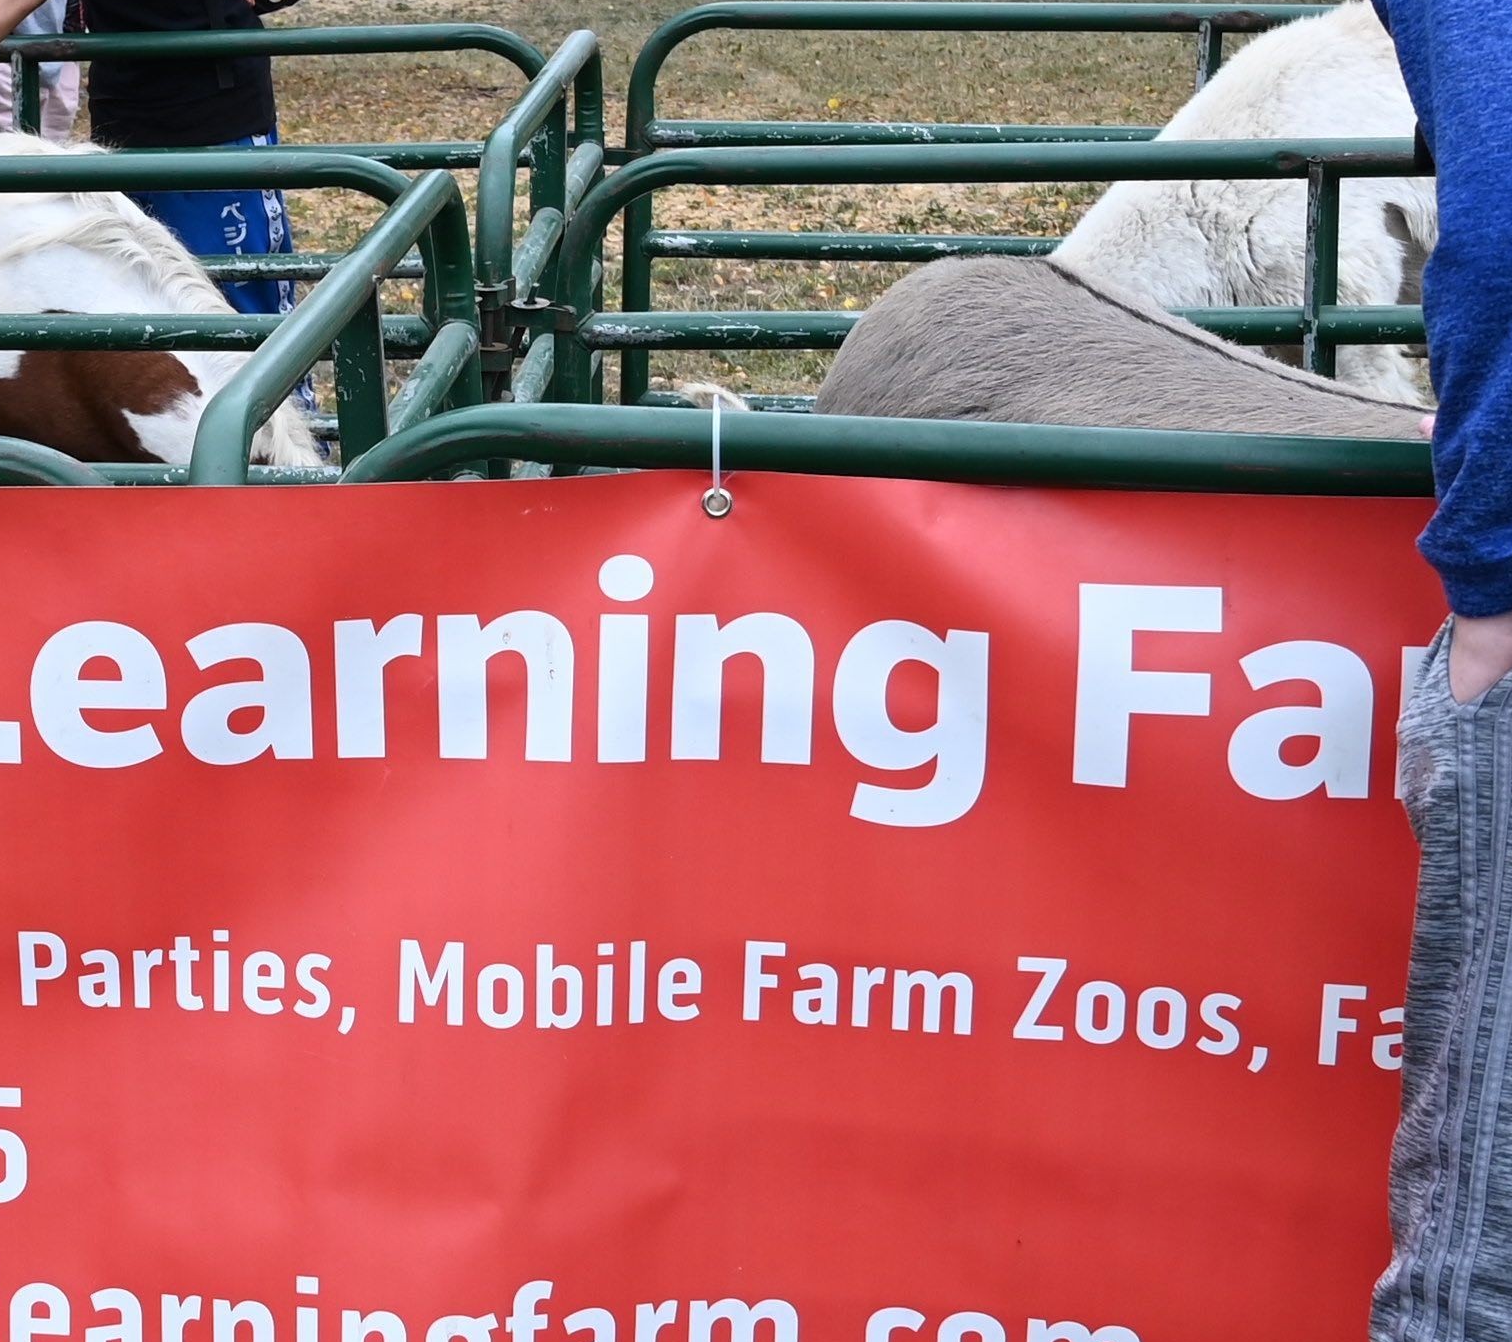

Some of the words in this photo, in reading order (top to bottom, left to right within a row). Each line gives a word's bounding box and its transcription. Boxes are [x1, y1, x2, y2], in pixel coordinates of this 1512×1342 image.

[1073, 581, 1430, 801] Fa
[18, 929, 357, 1036] Parties,
[398, 939, 703, 1030] Mobile
[743, 940, 975, 1036] Farm
[1013, 956, 1269, 1073] Zoos,
